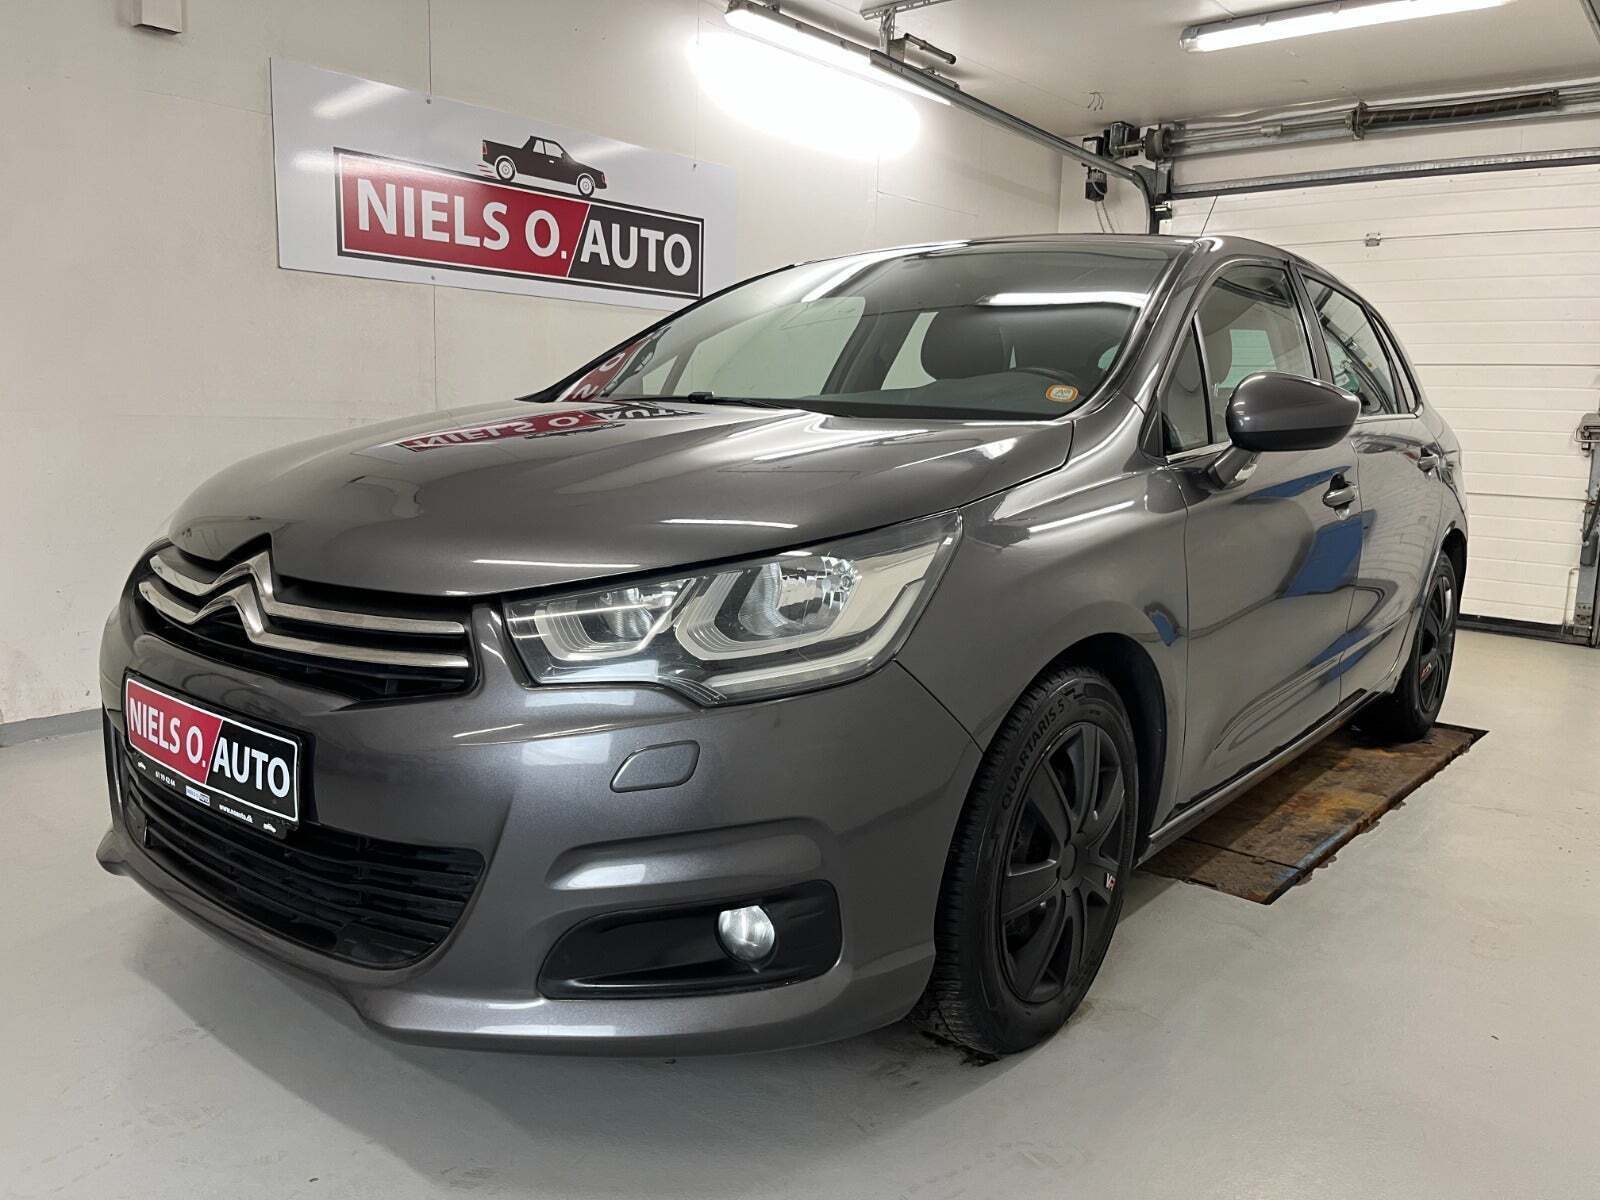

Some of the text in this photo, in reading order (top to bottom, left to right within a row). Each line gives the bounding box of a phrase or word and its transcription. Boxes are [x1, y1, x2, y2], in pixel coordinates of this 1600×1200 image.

[357, 178, 692, 276] NIELS O. AUTO
[129, 697, 290, 798] NIELS O. AUTO
[1002, 708, 1057, 810] QUARTARIS
